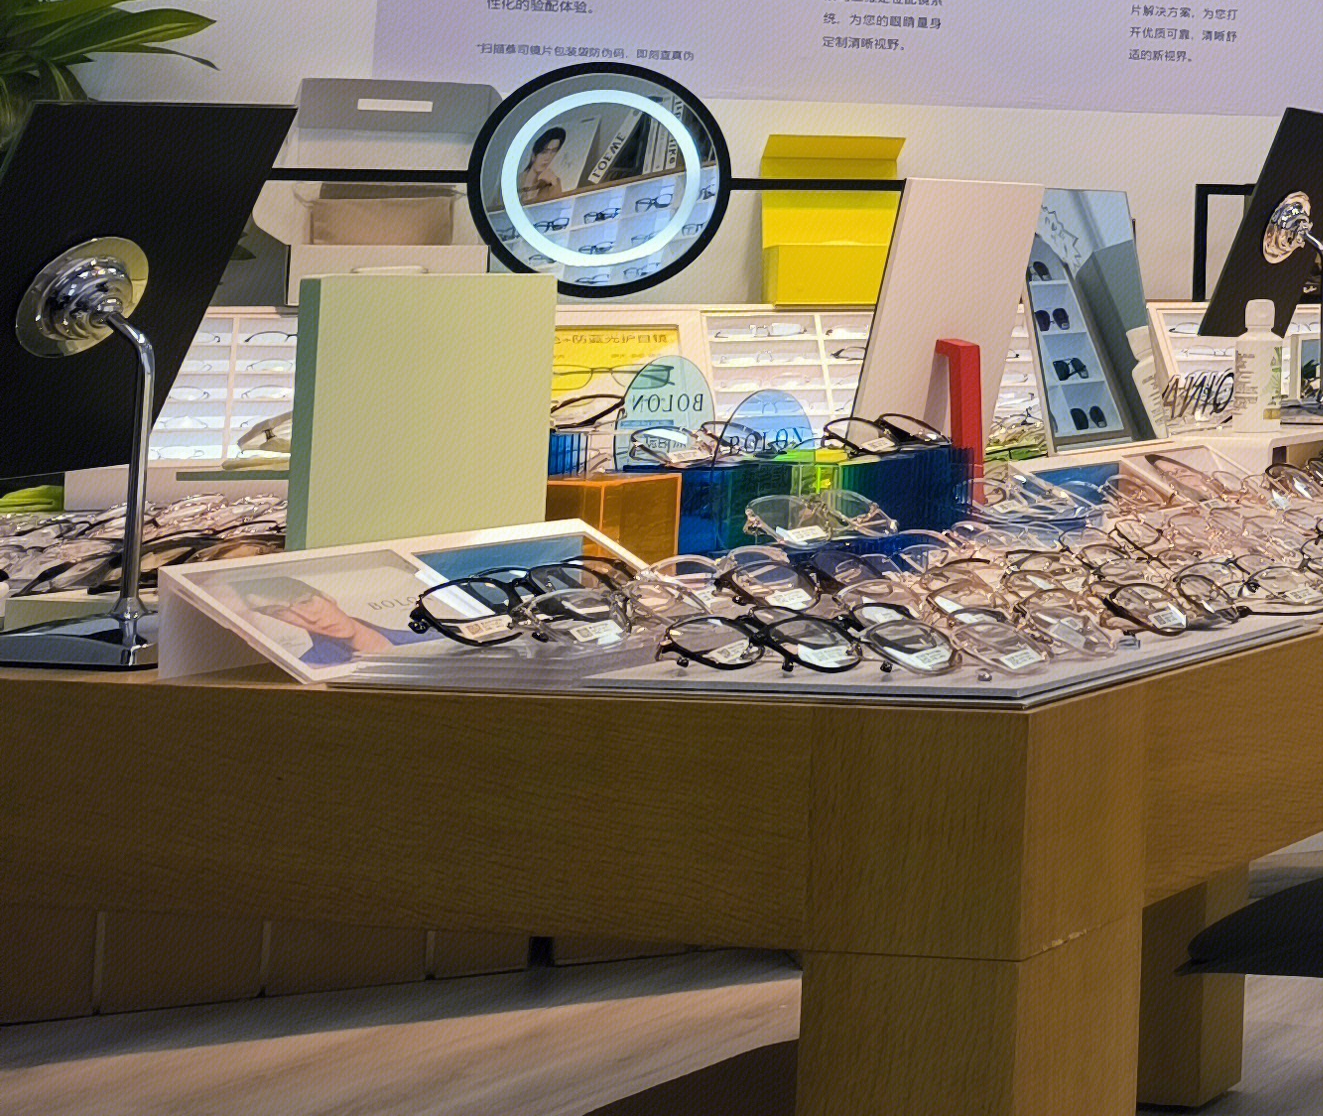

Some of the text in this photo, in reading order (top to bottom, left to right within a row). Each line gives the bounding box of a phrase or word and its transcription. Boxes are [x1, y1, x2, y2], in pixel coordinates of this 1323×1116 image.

[822, 36, 905, 51] 定制清晰视野。
[1128, 48, 1193, 63] 适的新视界。
